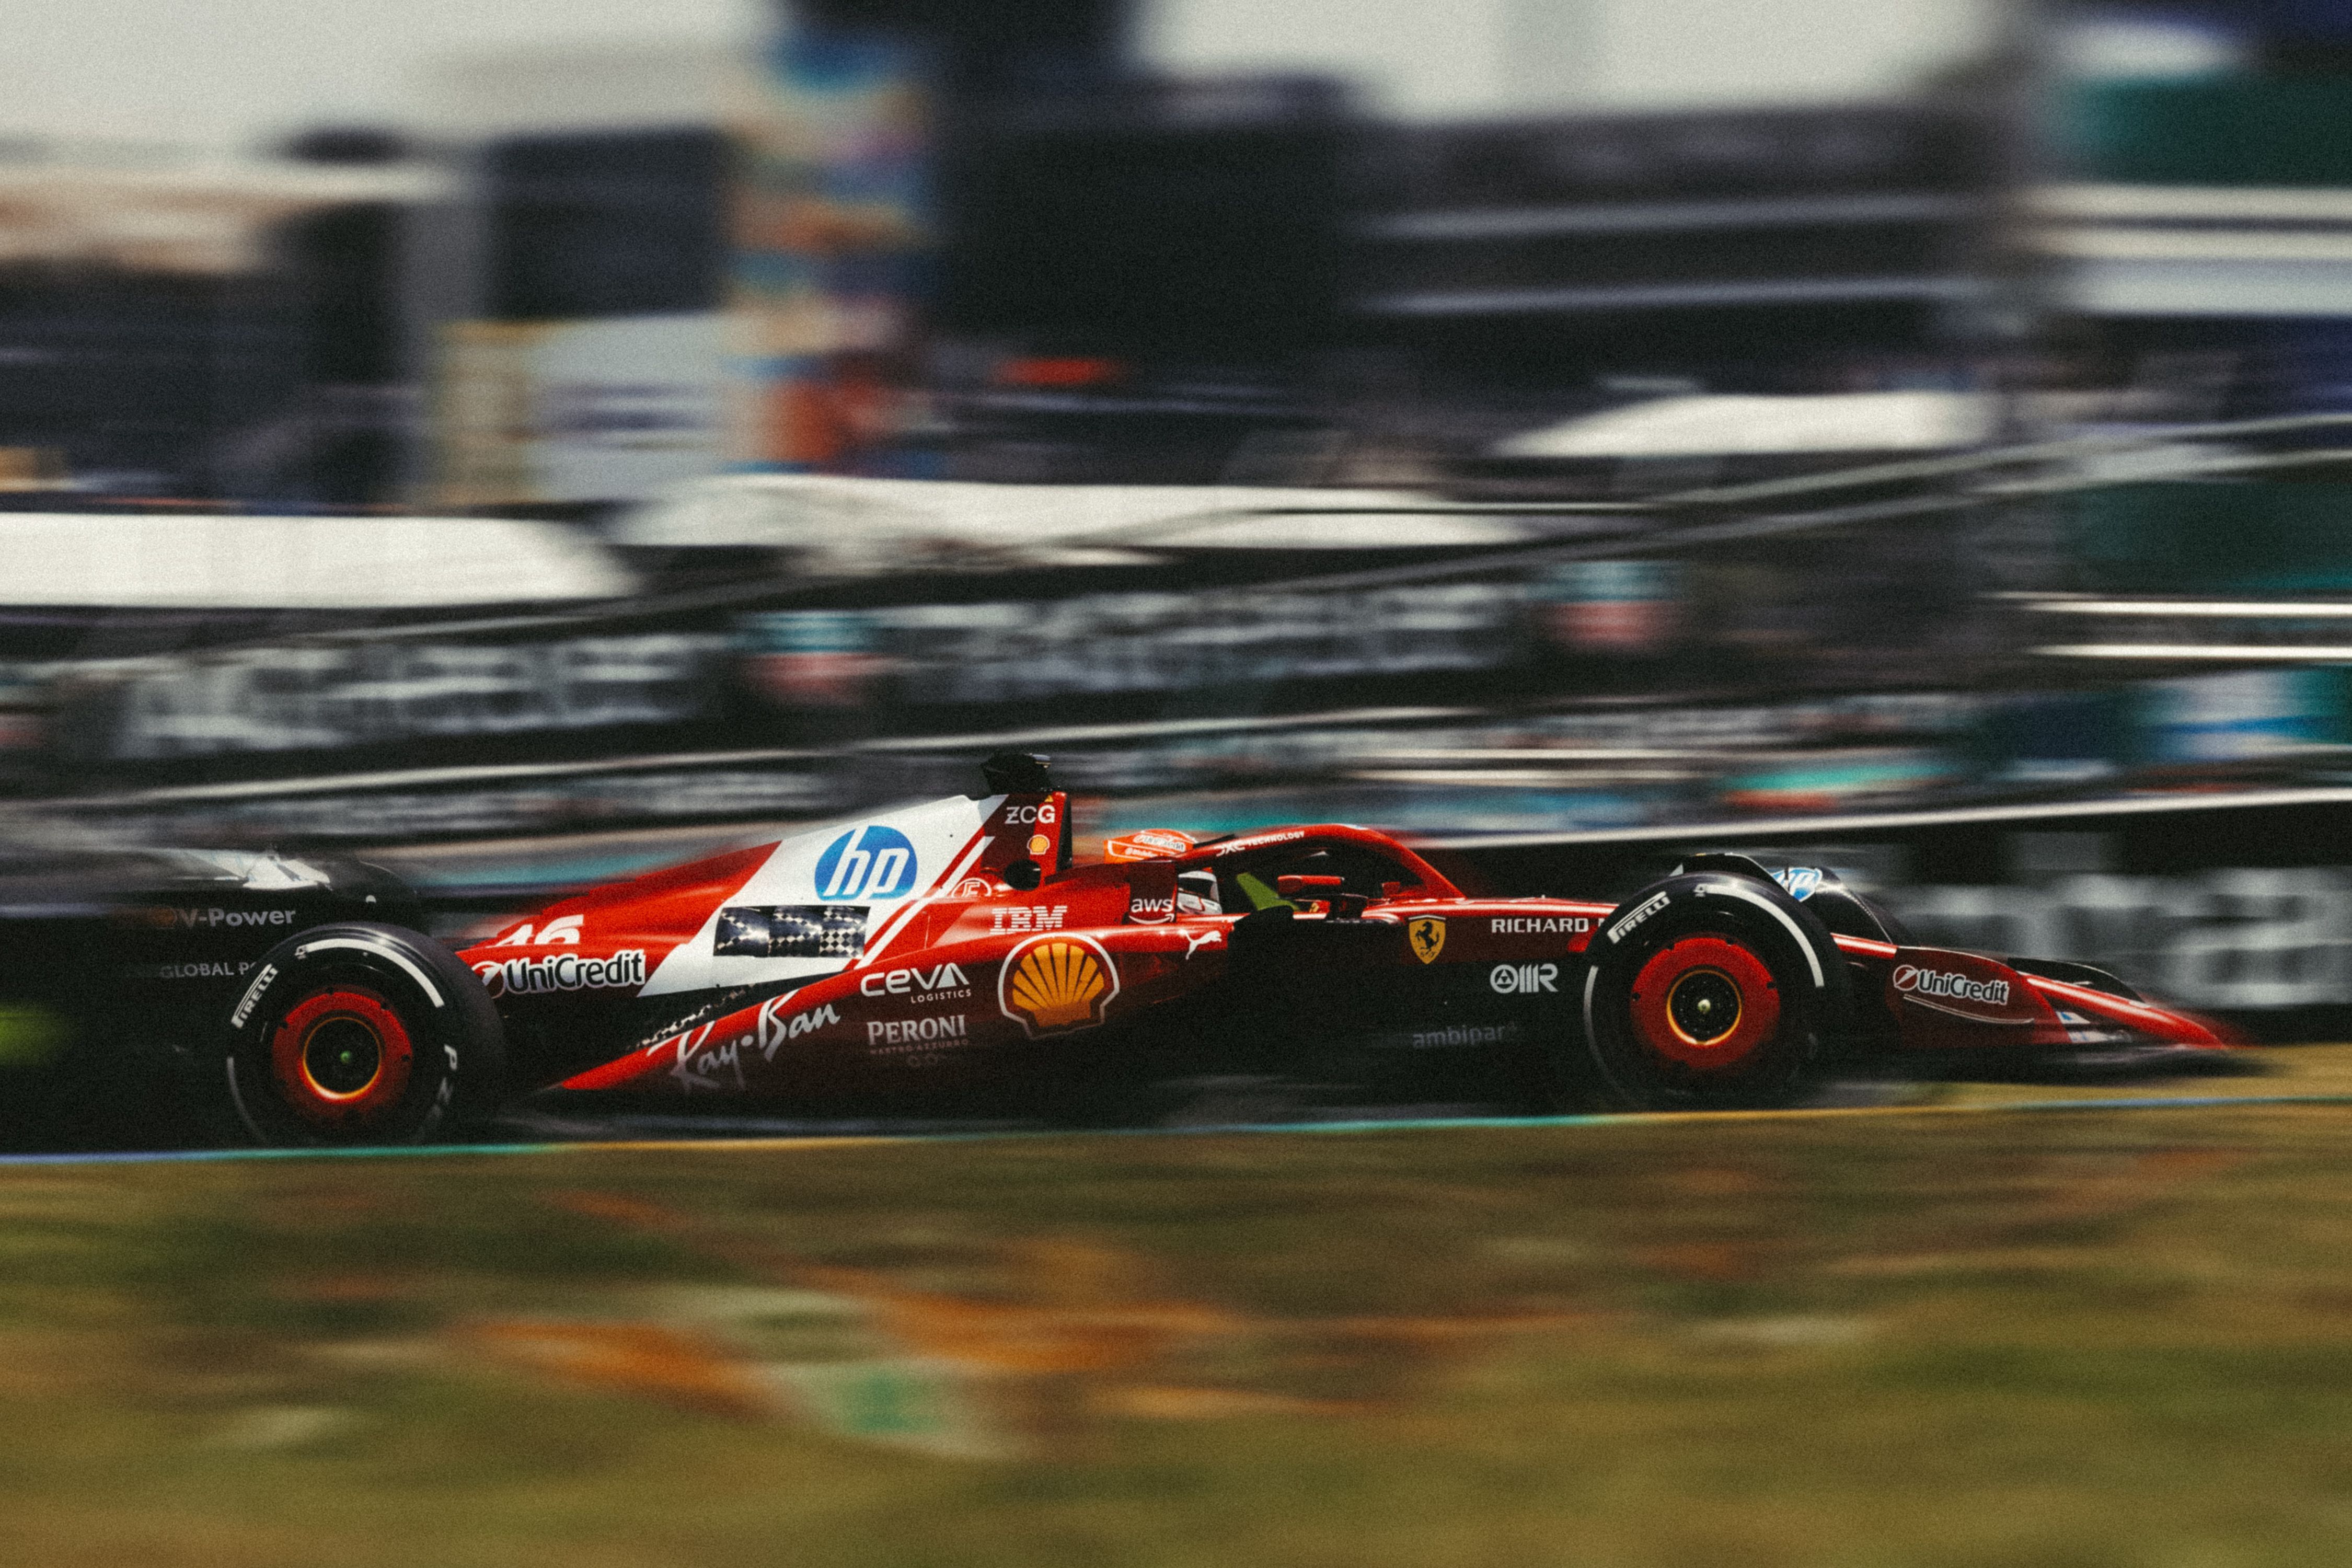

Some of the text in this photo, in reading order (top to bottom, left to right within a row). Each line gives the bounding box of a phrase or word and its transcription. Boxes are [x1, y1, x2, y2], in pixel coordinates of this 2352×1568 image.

[1246, 831, 1305, 847] TECHNOLOGY
[822, 826, 910, 900] hp
[180, 908, 296, 927] V-Power
[1131, 898, 1173, 913] aws
[1607, 891, 1671, 944] PIRELLI
[989, 905, 1068, 935] IBM
[1491, 918, 1589, 933] RICHARD
[160, 962, 235, 978] GLOBAL
[506, 949, 645, 994] UniCredit
[231, 963, 279, 1029] PIRELLI
[910, 988, 971, 1004] LOGISTICS
[1918, 969, 2009, 1006] UniCredit
[867, 1014, 966, 1045] PERONI
[1413, 1024, 1505, 1048] ambipar
